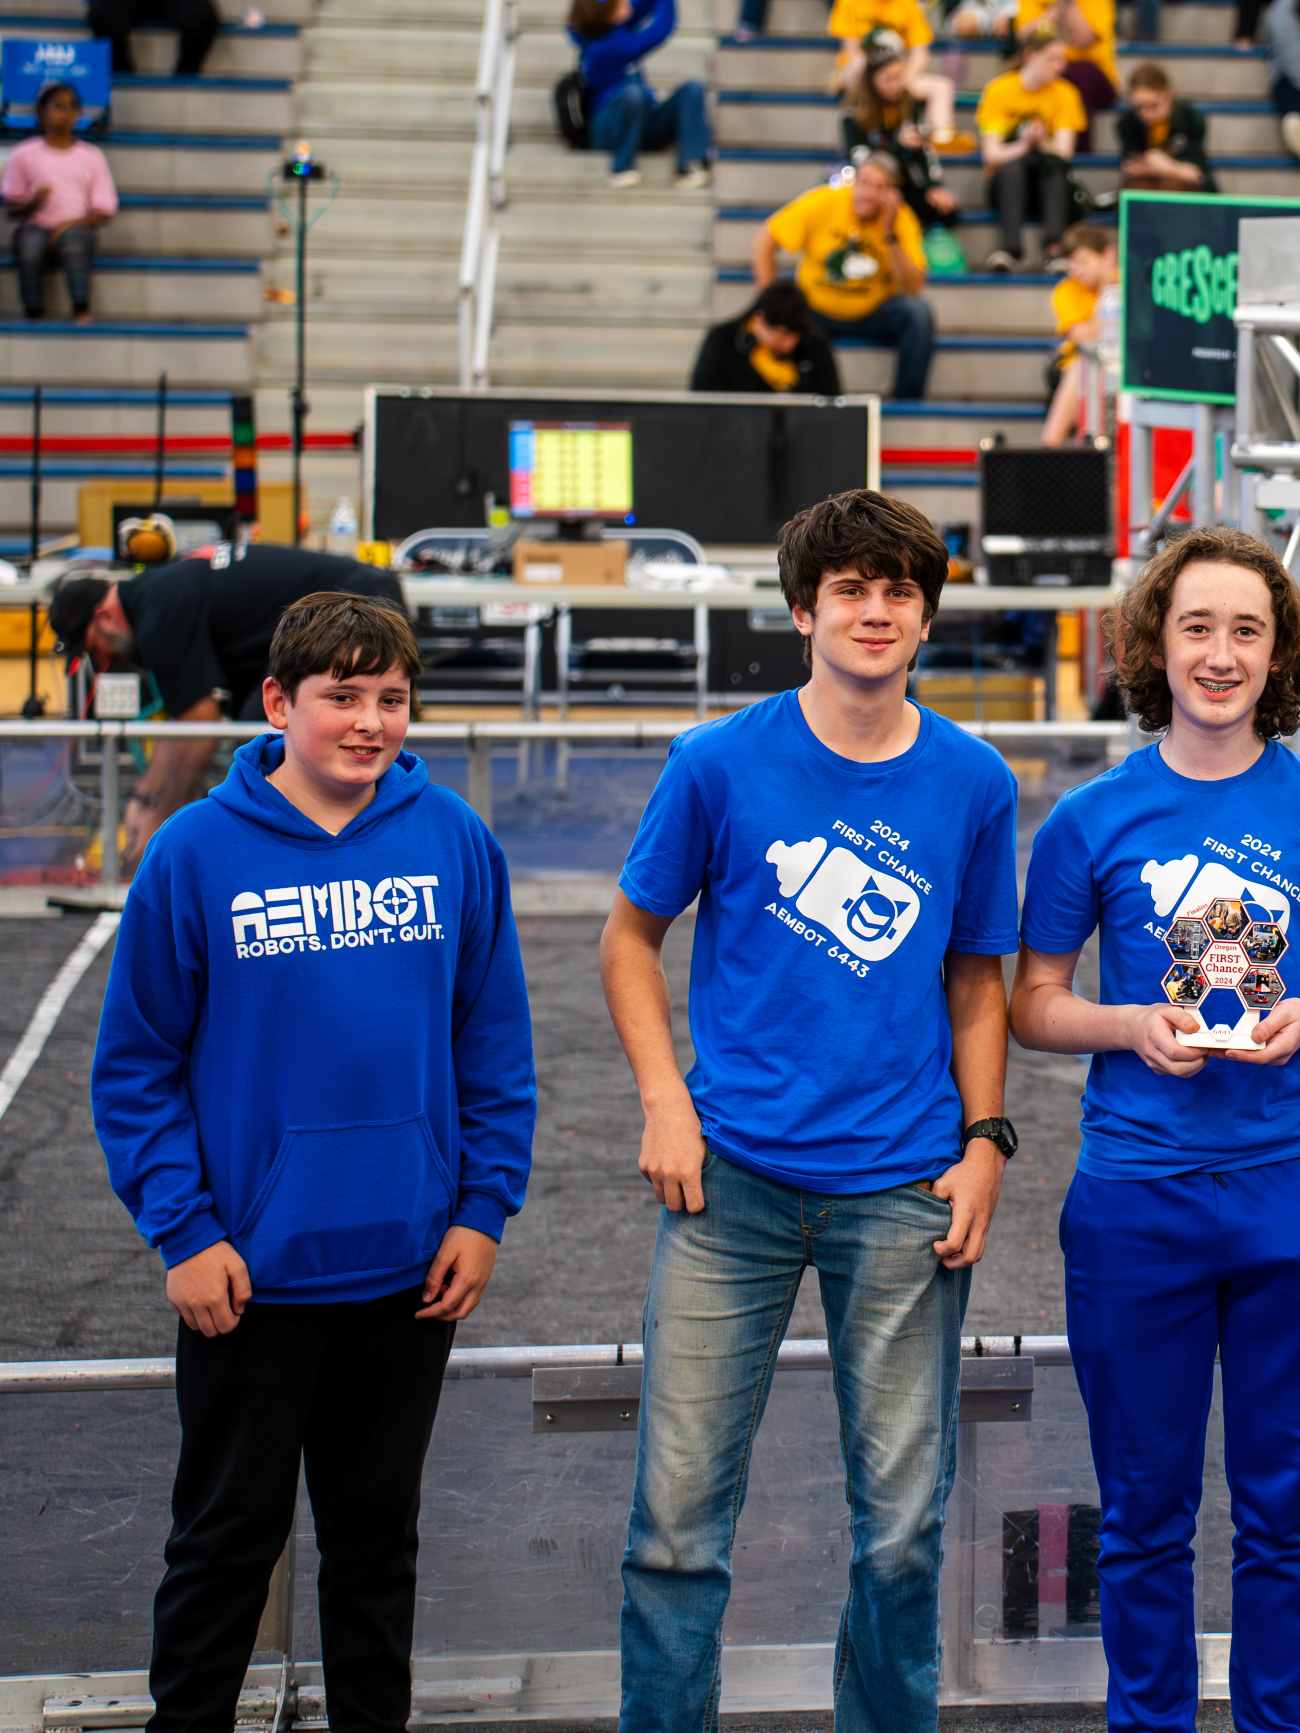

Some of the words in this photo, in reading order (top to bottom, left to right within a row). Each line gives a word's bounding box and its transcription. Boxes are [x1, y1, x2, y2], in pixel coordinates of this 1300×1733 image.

[1152, 244, 1239, 323] CRESCE
[869, 819, 911, 852] 2024
[1202, 836, 1248, 864] FIRST
[1240, 833, 1282, 861] 2024
[832, 819, 876, 851] FIRST
[877, 850, 932, 895] CHANCE
[231, 875, 439, 943] AEMBOT
[235, 935, 327, 960] ROBOTS.
[330, 928, 395, 949] DON'T.
[400, 924, 445, 942] QUIT.
[764, 902, 826, 947] AEMBOT
[827, 946, 870, 978] 6443
[1205, 963, 1244, 974] Chance
[1209, 953, 1241, 964] FIRST
[1214, 977, 1233, 985] 2024
